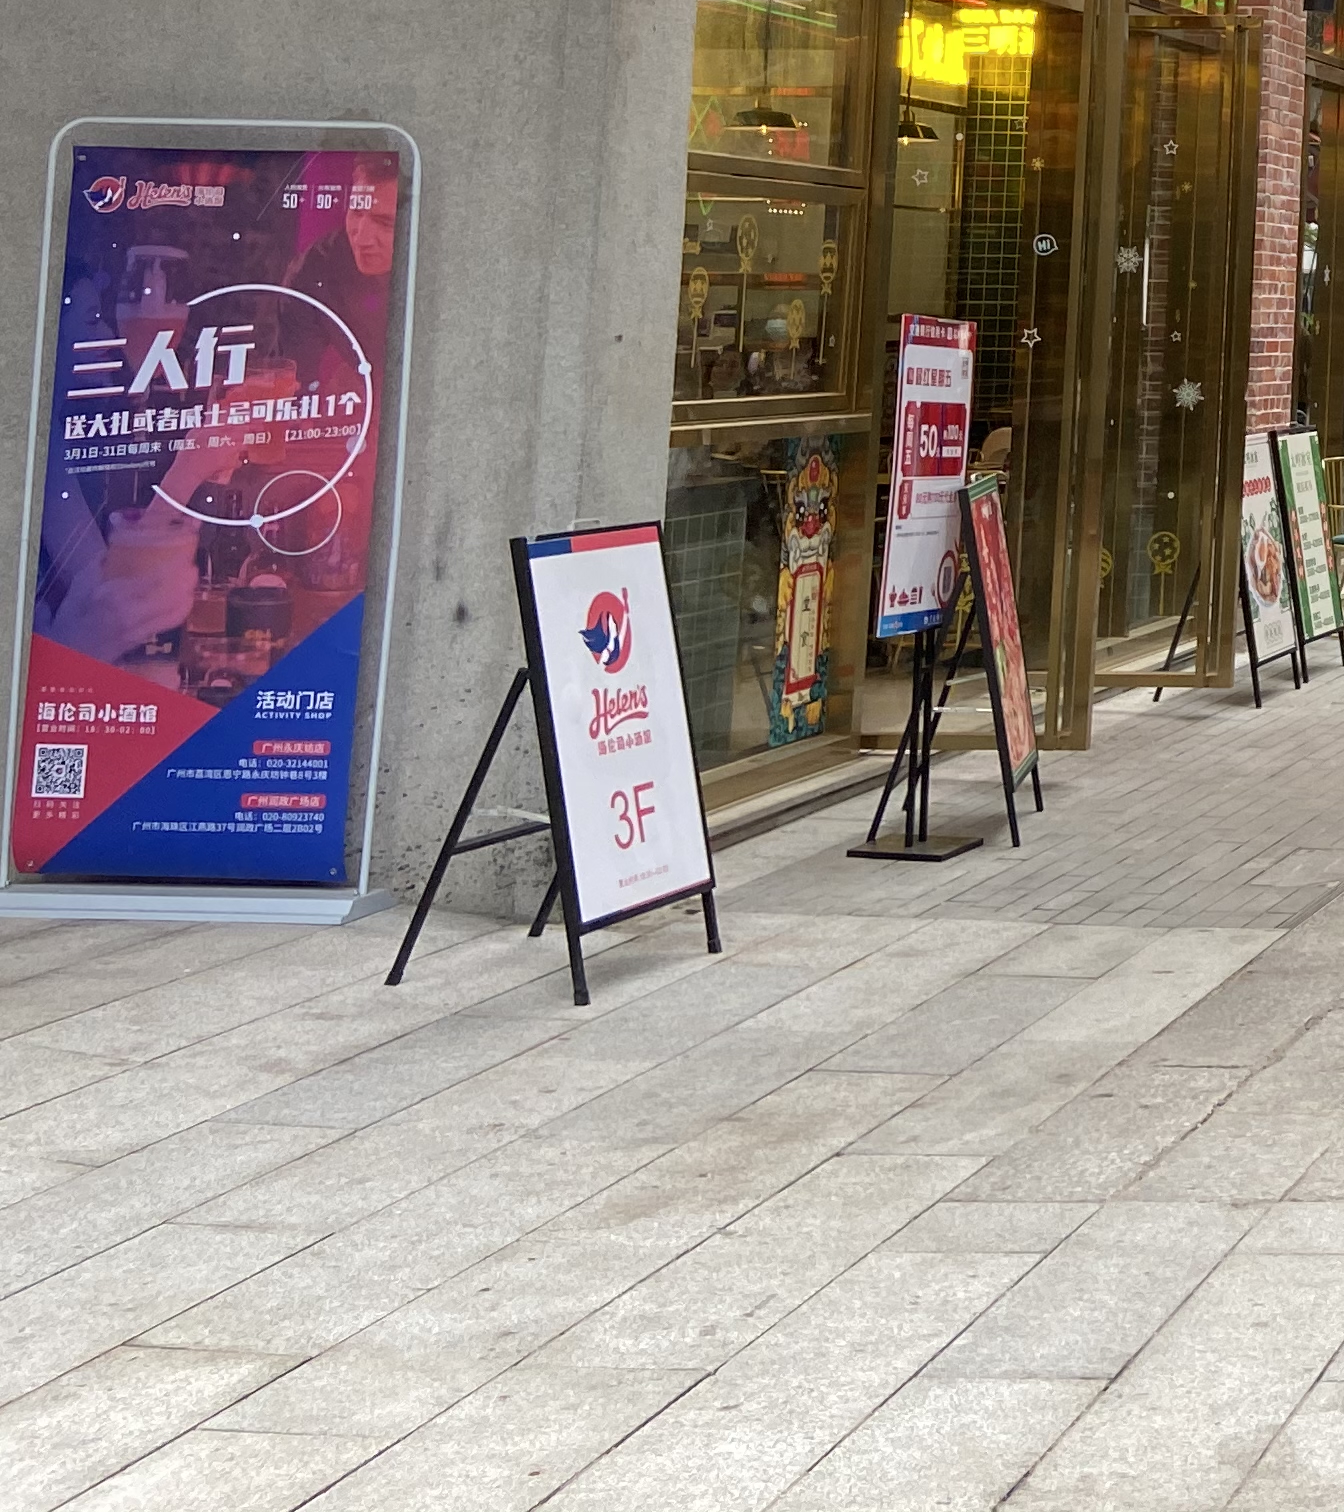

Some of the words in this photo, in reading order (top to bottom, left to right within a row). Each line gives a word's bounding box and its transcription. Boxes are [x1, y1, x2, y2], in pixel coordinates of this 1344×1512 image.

[67, 324, 255, 399] 三人行
[37, 702, 158, 724] 海伦司小酒馆
[255, 711, 301, 720] ACTIVITY
[305, 711, 332, 720] SHOP
[256, 690, 335, 711] 活动门店
[589, 683, 650, 740] Helen's
[609, 781, 655, 850] 3F
